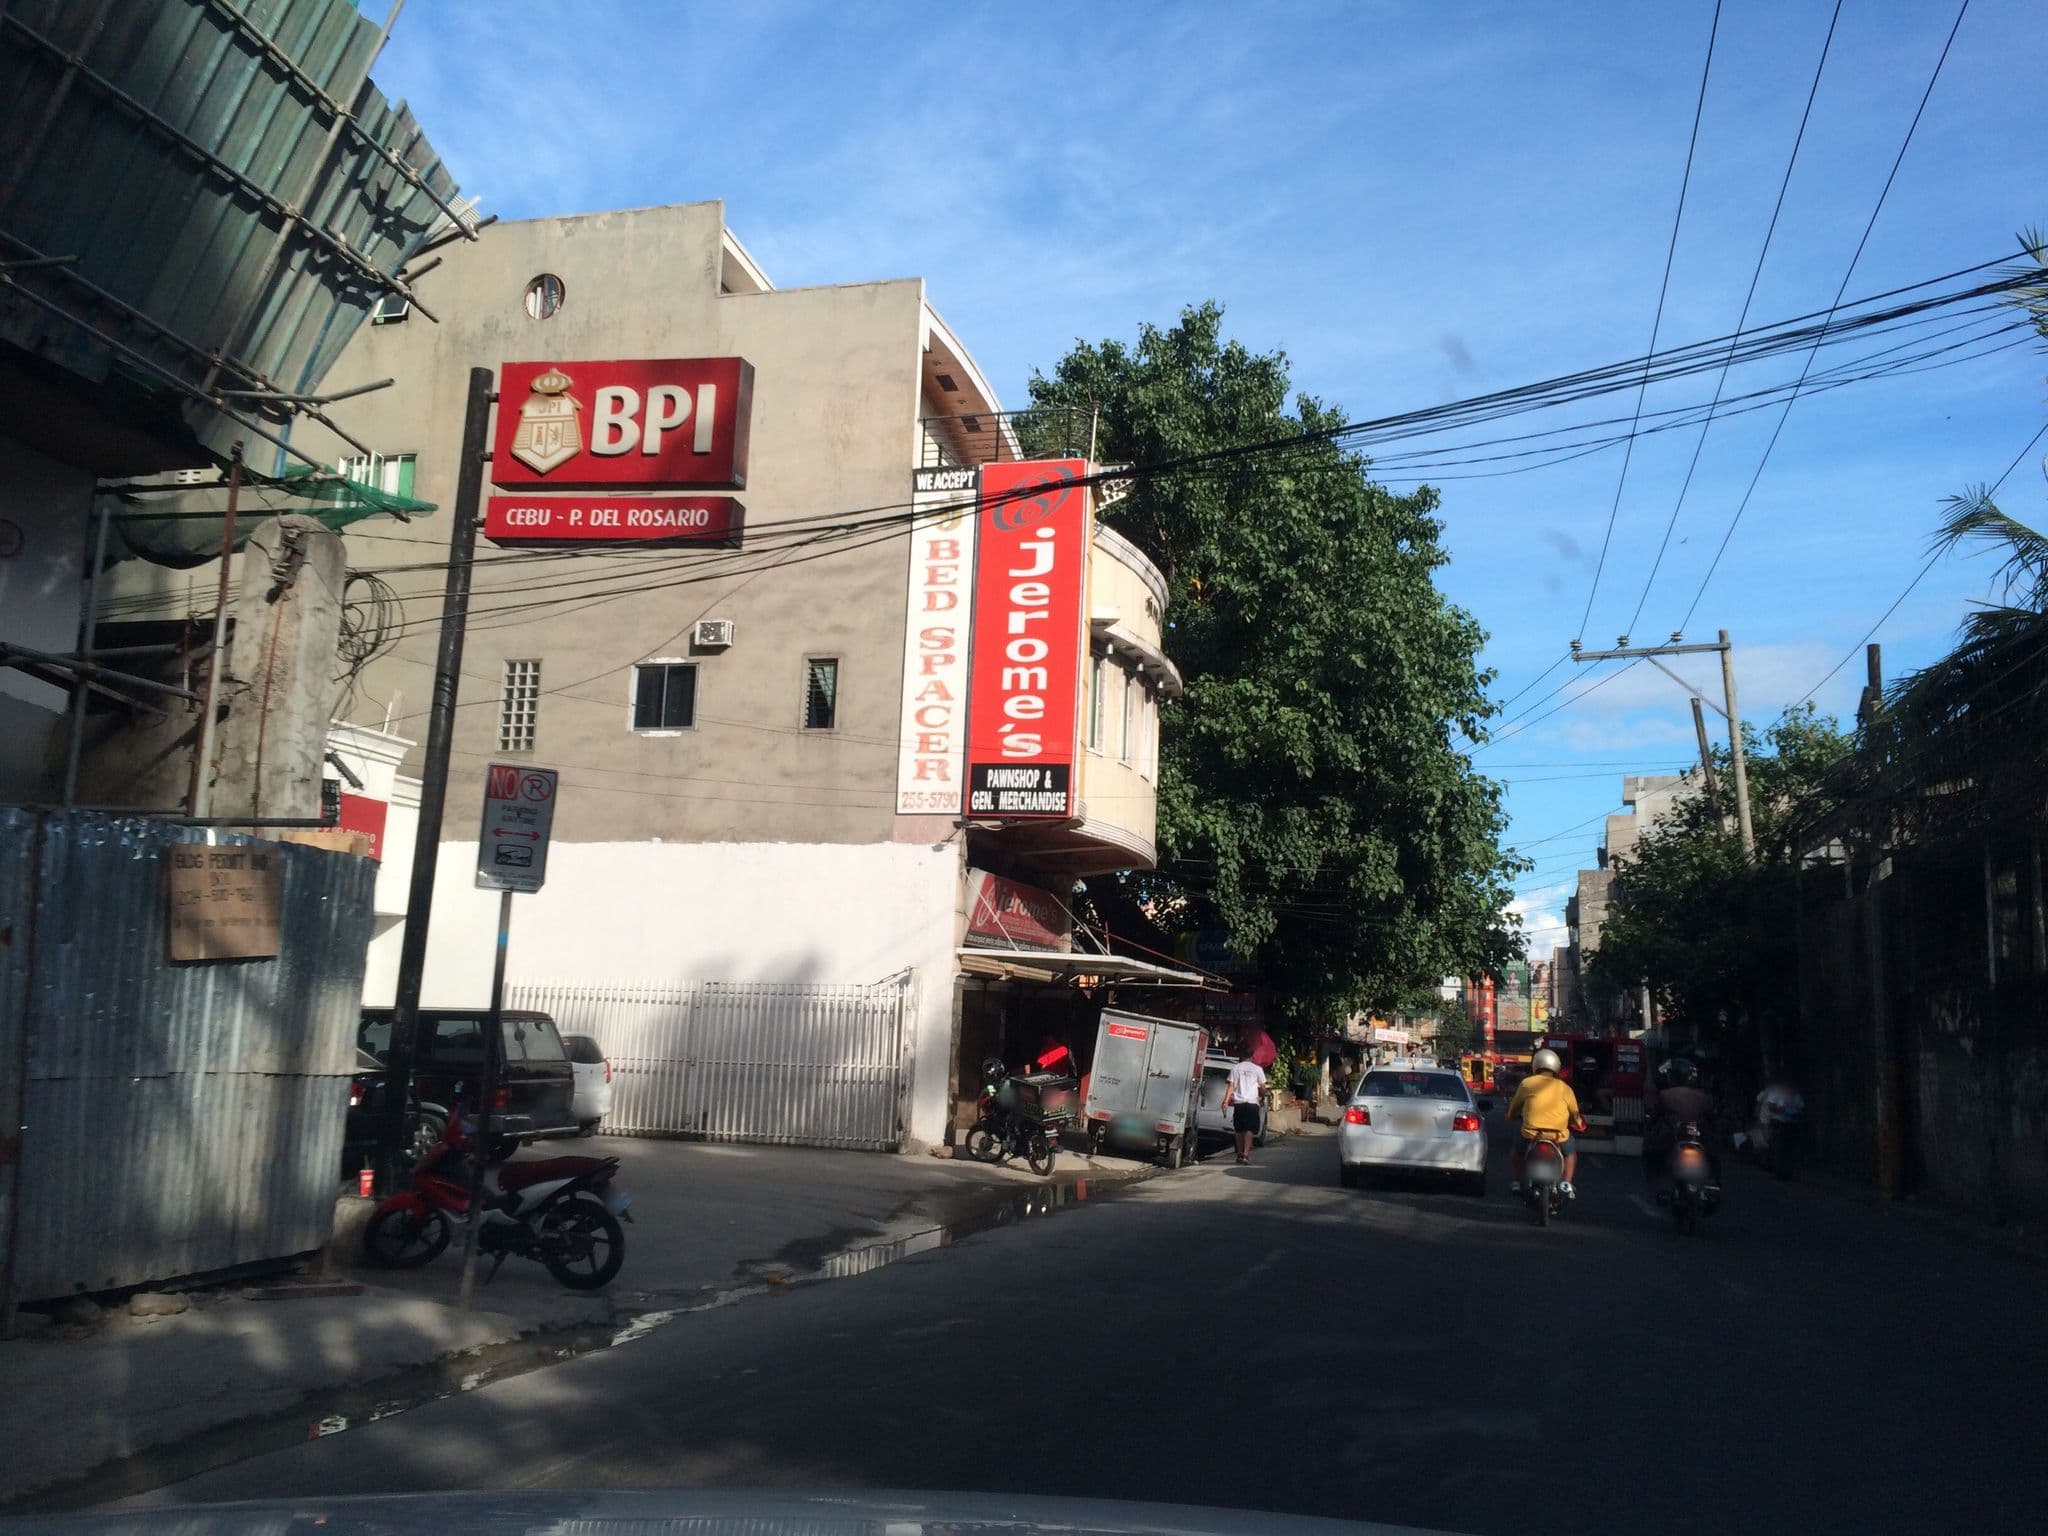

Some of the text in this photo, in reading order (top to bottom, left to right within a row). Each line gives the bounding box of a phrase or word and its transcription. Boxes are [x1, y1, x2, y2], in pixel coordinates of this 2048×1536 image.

[590, 384, 717, 455] BPI
[916, 471, 975, 490] WE ACCEPT
[505, 508, 551, 526] CEBU
[569, 509, 583, 526] P.
[590, 509, 621, 526] DEL
[627, 509, 709, 527] ROSARIO
[997, 527, 1057, 758] jerome's
[913, 538, 962, 782] BED SPACER
[489, 768, 516, 798] NO
[987, 769, 1053, 790] PAWNSHOP &
[971, 790, 1067, 812] GEN. MERCHANDISE
